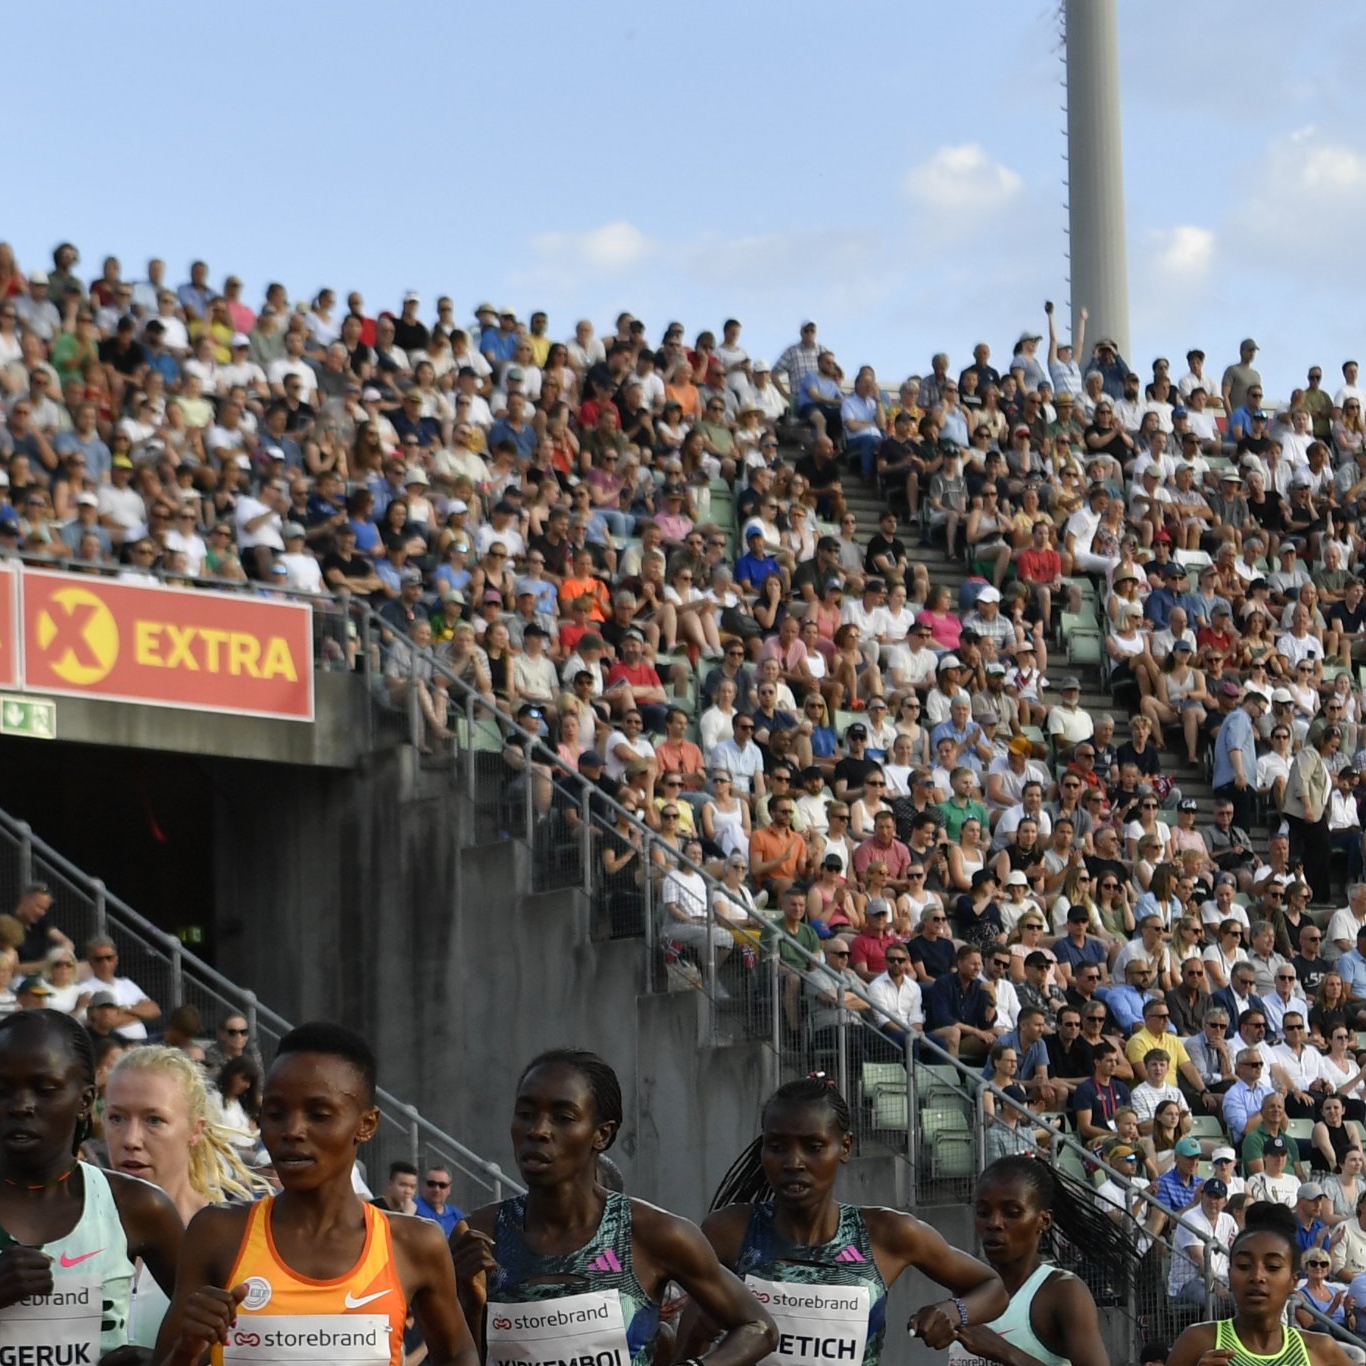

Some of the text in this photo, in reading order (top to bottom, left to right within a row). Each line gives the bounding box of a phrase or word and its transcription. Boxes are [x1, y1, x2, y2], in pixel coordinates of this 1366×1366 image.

[135, 619, 299, 682] EXTRA
[15, 1288, 89, 1306] ebrand
[772, 1293, 858, 1311] storebrand
[514, 1303, 609, 1329] storebrand
[264, 1329, 376, 1347] storebrand
[778, 1334, 857, 1360] ETICH
